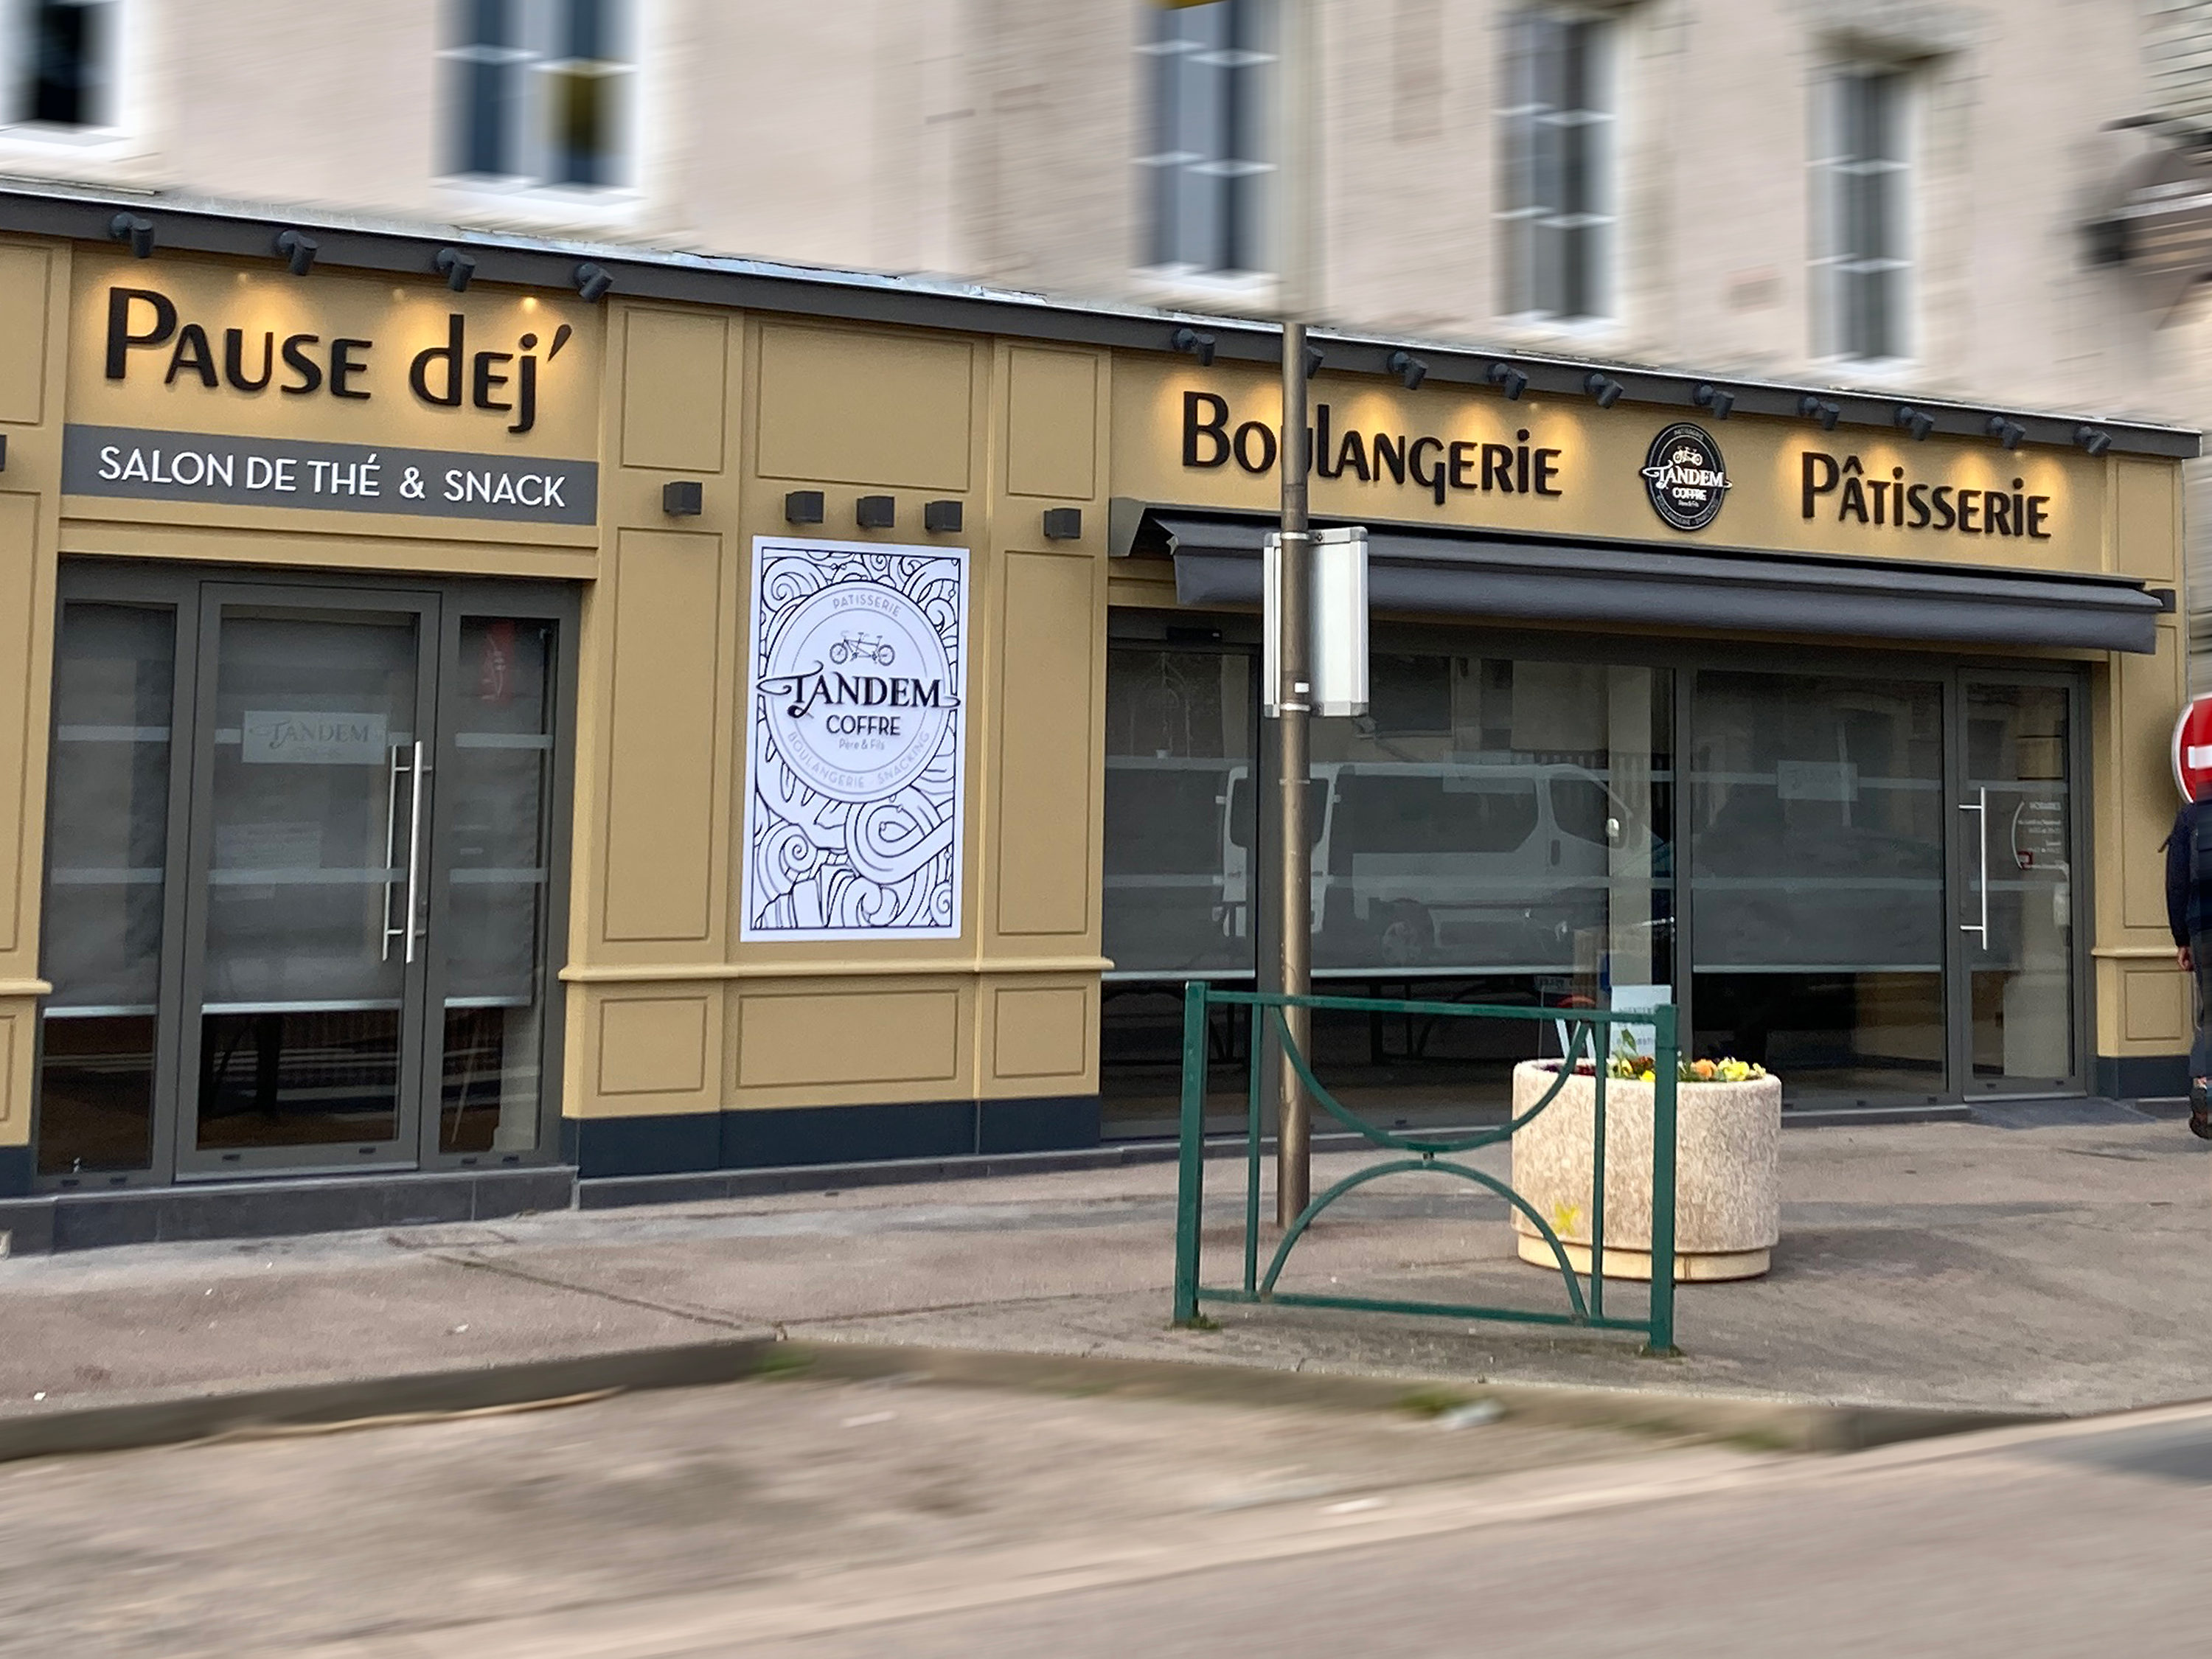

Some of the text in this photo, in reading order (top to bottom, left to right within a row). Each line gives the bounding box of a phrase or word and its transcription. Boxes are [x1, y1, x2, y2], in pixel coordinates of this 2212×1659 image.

[98, 445, 566, 508] SALON DE THÉ & SNACK
[1642, 459, 1733, 490] TANDEM
[832, 594, 902, 617] PATISSERIE
[757, 660, 961, 718] TANDEM
[826, 714, 901, 737] COFFRE
[787, 731, 865, 788] BOULANGERIE
